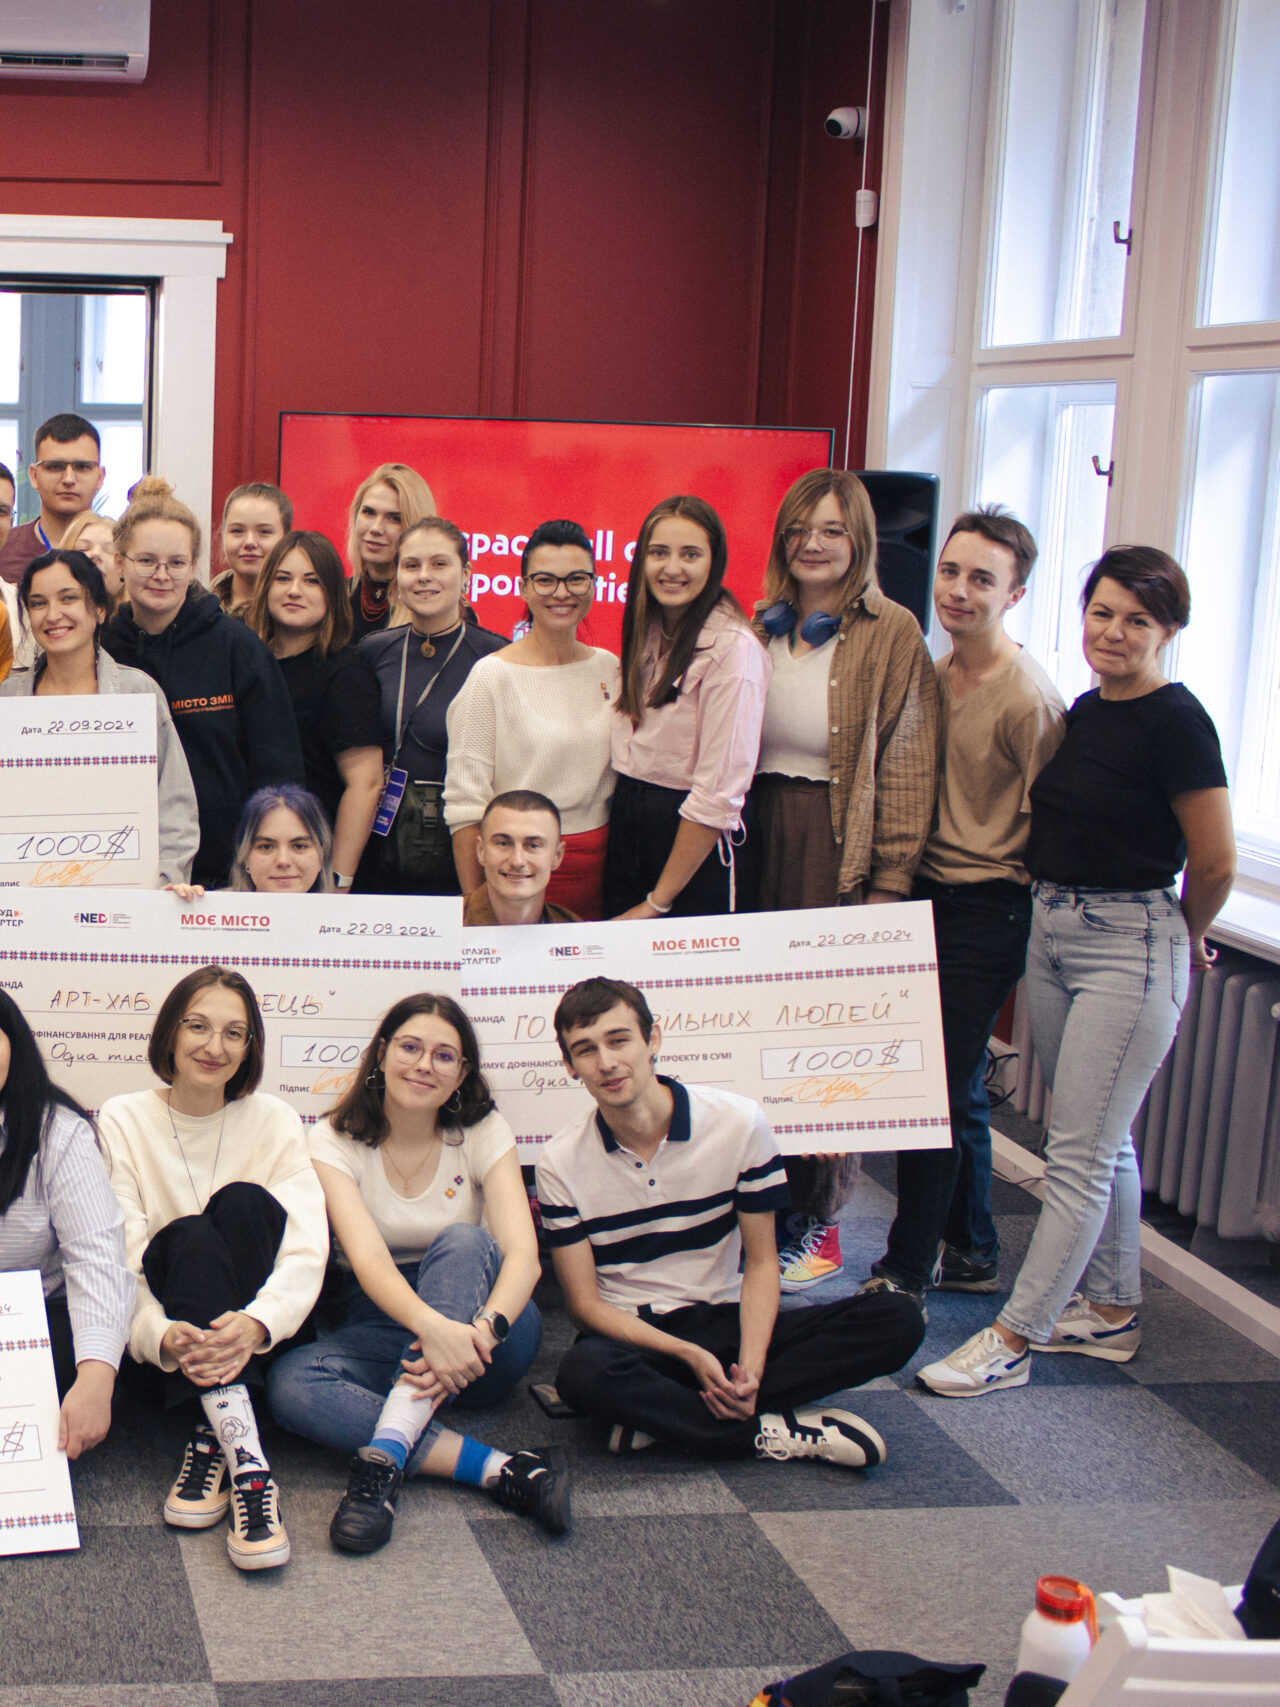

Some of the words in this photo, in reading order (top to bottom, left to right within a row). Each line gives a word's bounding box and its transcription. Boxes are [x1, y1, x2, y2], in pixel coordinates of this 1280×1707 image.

[461, 532, 530, 561] pac
[171, 697, 208, 710] МІСТО
[21, 726, 42, 735] Дата
[80, 912, 108, 924] NED
[180, 914, 217, 926] МОЄ
[221, 914, 271, 928] МІСТО
[319, 925, 341, 935] Дата
[652, 939, 687, 951] МОЄ
[691, 936, 740, 950] МІСТО
[789, 939, 811, 949] Дата
[555, 946, 581, 957] NED
[50, 989, 153, 1011] АРТ-ХАБ
[468, 1015, 505, 1024] ОМАНДА
[514, 1014, 546, 1041] ГО
[31, 1030, 106, 1041] ОФІНАНСУВАННЯ
[108, 1032, 127, 1041] ДЛЯ
[129, 1033, 152, 1041] РЕАЛ
[50, 1042, 99, 1068] Одна
[480, 1061, 505, 1070] ИМУЄ
[507, 1060, 565, 1070] ДОФІНАНСУВ
[660, 1053, 700, 1062] ПРОЄКТУ
[702, 1053, 708, 1061] В
[709, 1052, 732, 1060] СУМІ
[279, 1085, 311, 1094] Підпис
[763, 1096, 794, 1105] Підпис
